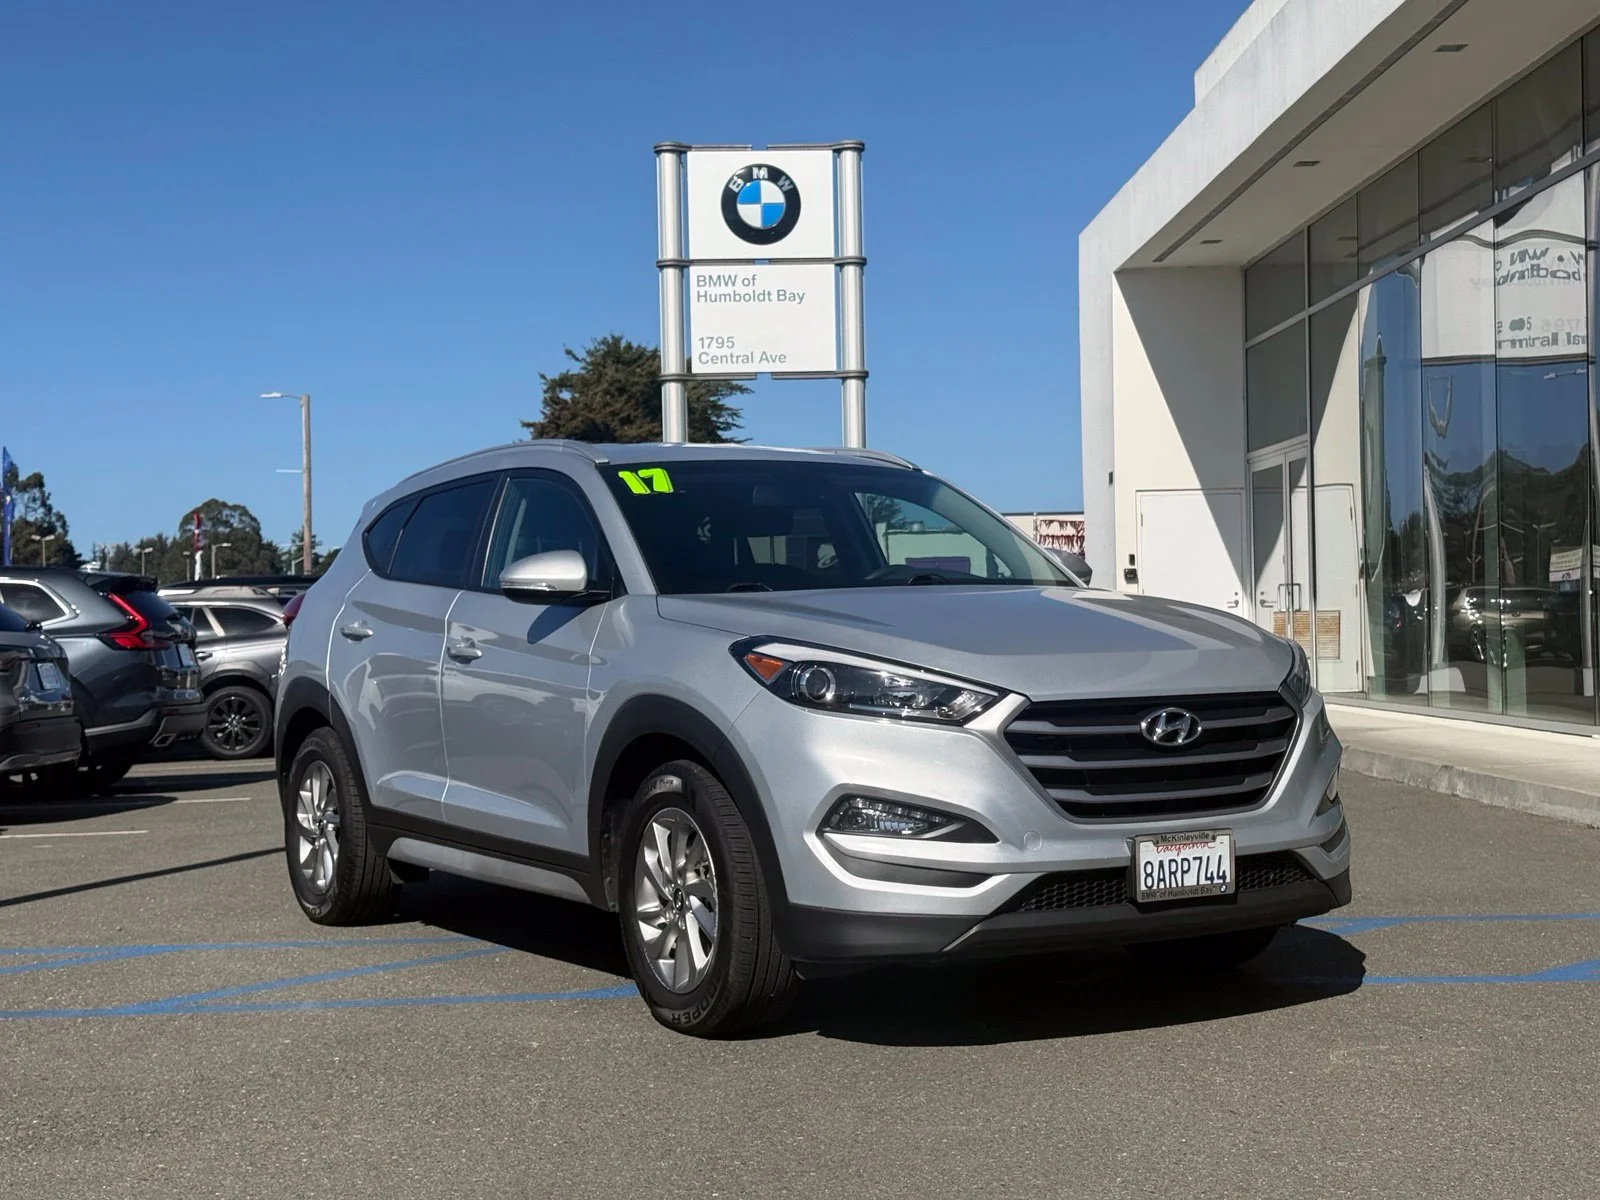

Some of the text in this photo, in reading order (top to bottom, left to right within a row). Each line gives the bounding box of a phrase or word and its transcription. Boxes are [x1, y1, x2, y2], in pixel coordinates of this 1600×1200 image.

[728, 166, 793, 193] BMW
[696, 274, 757, 288] BMW of
[696, 289, 806, 305] Humboldt Bay
[698, 336, 736, 350] 1795
[698, 351, 787, 365] Central Ave
[618, 468, 674, 494] 17
[1160, 832, 1210, 842] McKinleyville
[1143, 854, 1228, 890] 8ARP744
